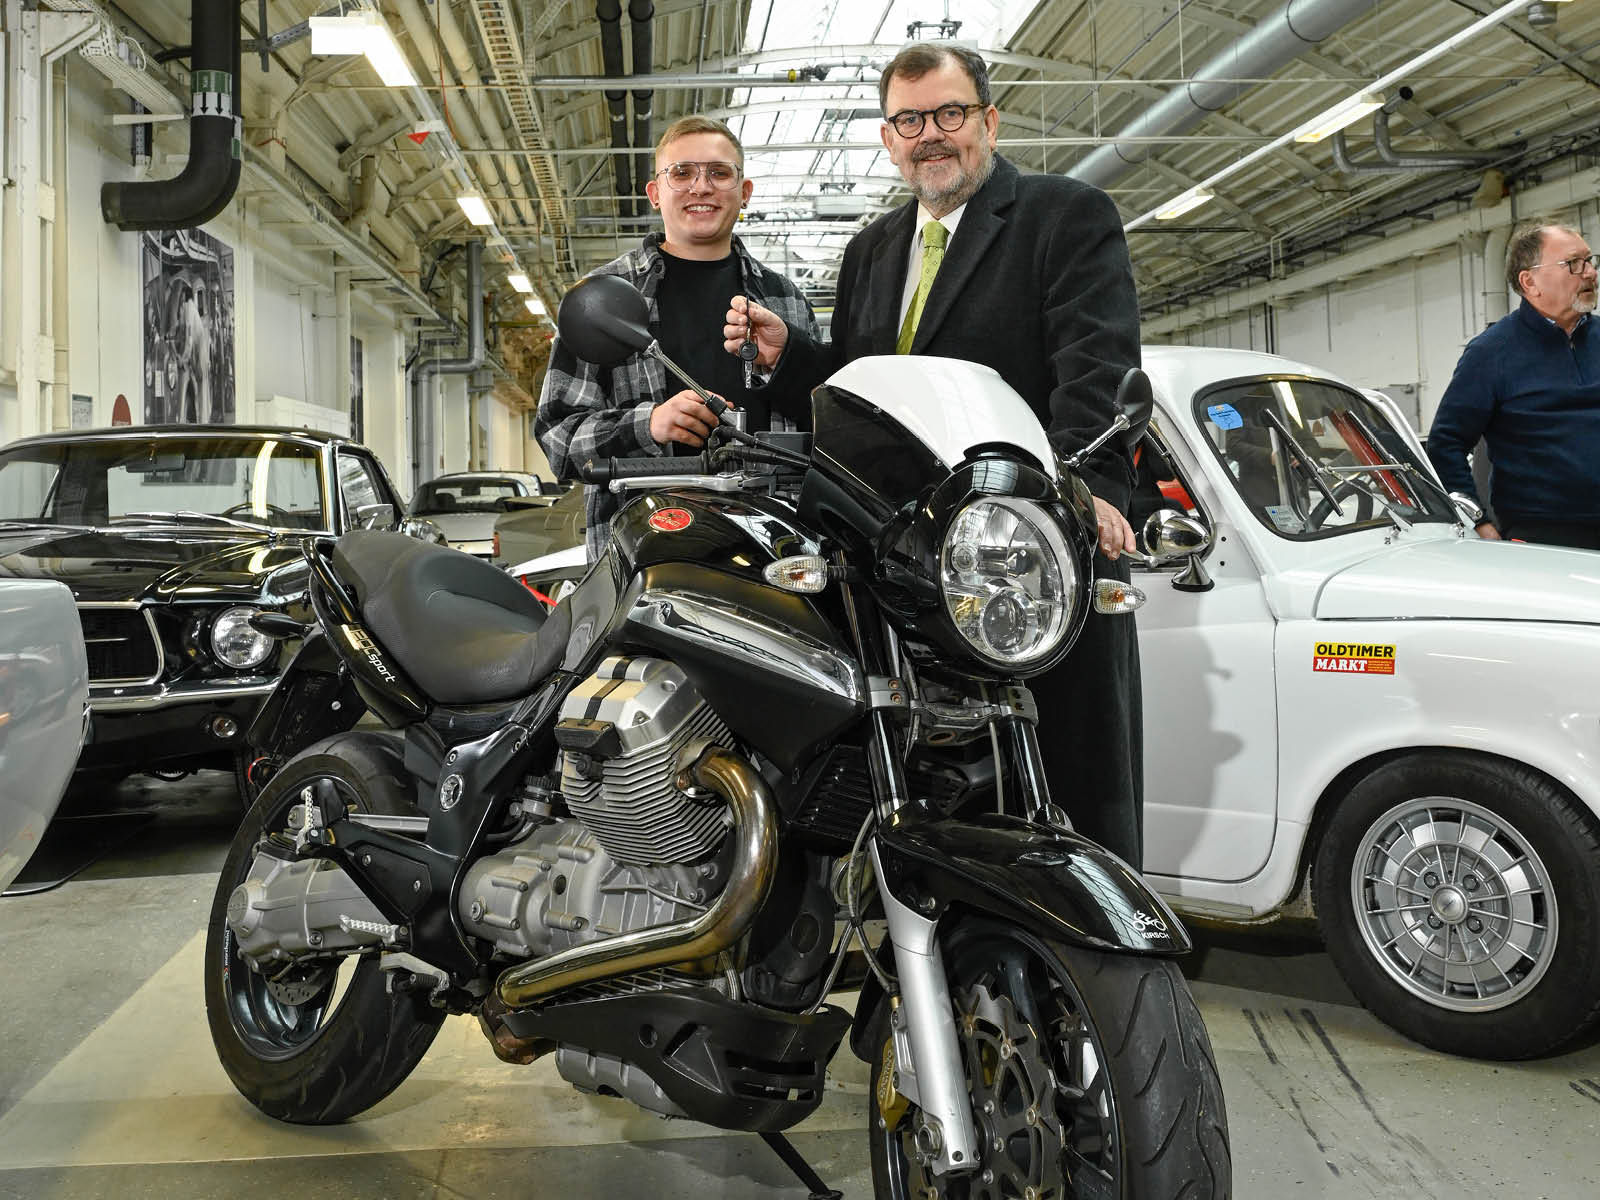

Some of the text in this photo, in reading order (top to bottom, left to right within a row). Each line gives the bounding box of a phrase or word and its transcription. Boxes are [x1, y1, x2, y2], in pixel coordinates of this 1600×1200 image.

[1316, 644, 1394, 658] OLDTIMER
[368, 653, 396, 683] sport
[1315, 658, 1368, 672] MARKT
[1142, 931, 1170, 939] KIRSCH
